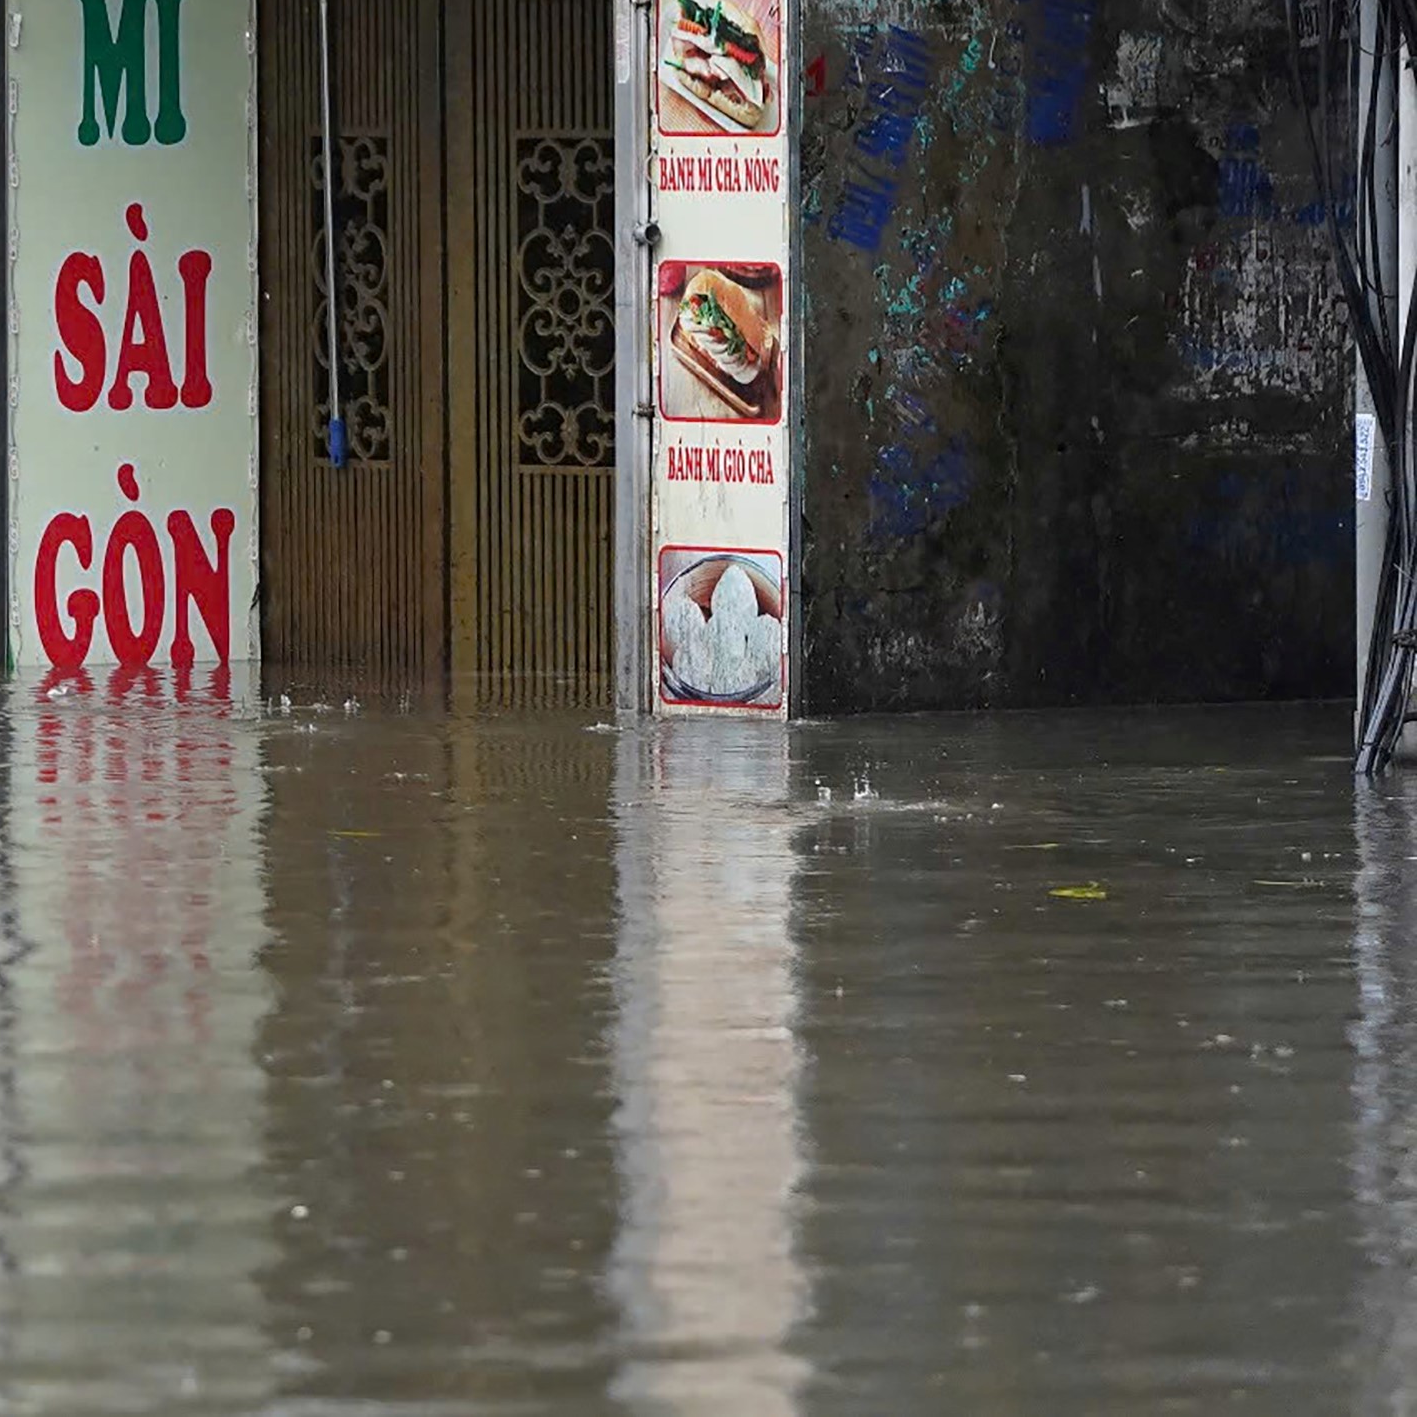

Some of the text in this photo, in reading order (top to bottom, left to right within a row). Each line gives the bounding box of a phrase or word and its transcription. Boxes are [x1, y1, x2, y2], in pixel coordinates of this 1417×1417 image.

[659, 143, 780, 194] BÁNH MÌ CHẢ NÓNG
[54, 202, 213, 412] SÀI
[667, 436, 775, 484] BÁNH MÌ GIÒ CHẢ
[33, 463, 236, 670] GÒN
